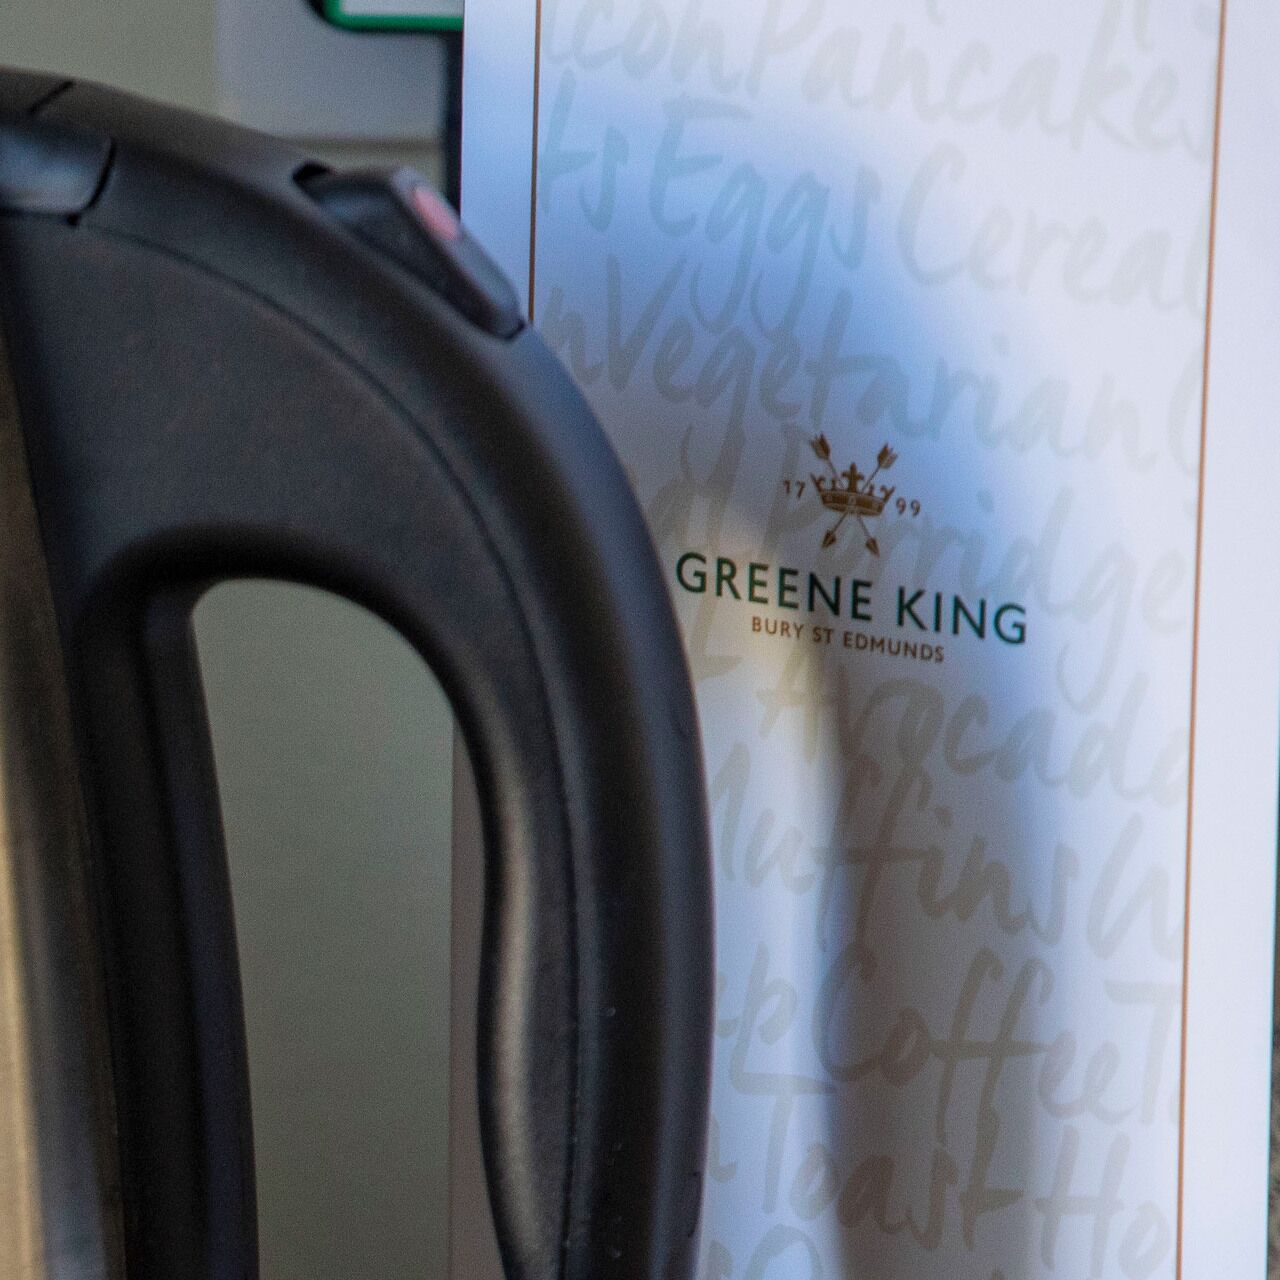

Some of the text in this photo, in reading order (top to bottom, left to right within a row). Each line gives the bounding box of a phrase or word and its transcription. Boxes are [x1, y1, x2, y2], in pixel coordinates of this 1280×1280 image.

[895, 497, 922, 517] 99
[675, 551, 1028, 645] GREENE KING
[751, 615, 946, 664] BURY ST EDMUNDS
